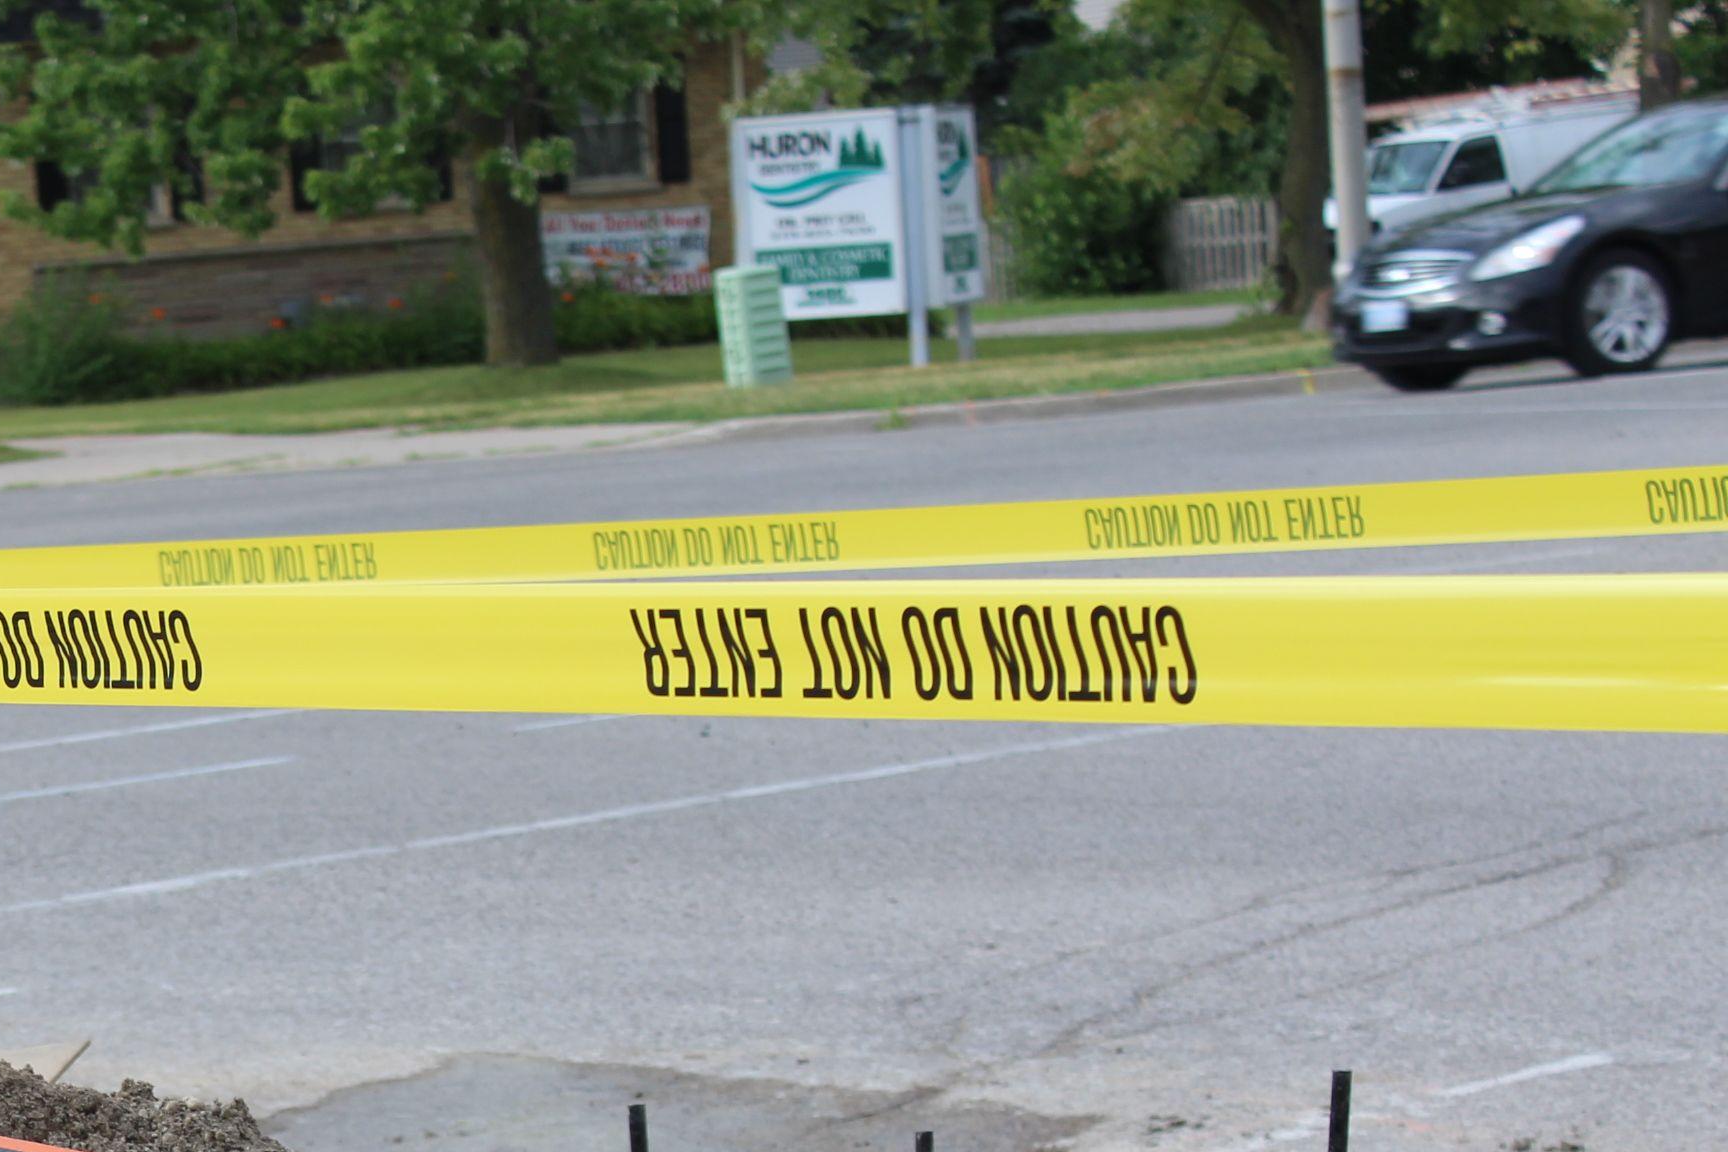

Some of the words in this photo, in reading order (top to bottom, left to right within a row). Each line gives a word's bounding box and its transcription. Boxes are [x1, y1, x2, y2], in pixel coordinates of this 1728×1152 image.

[749, 130, 831, 158] HURON
[44, 609, 203, 692] CAUTION
[629, 608, 783, 698] ENTER
[798, 606, 892, 700] NOT
[900, 606, 974, 701] DO
[979, 604, 1198, 706] CAUTION
